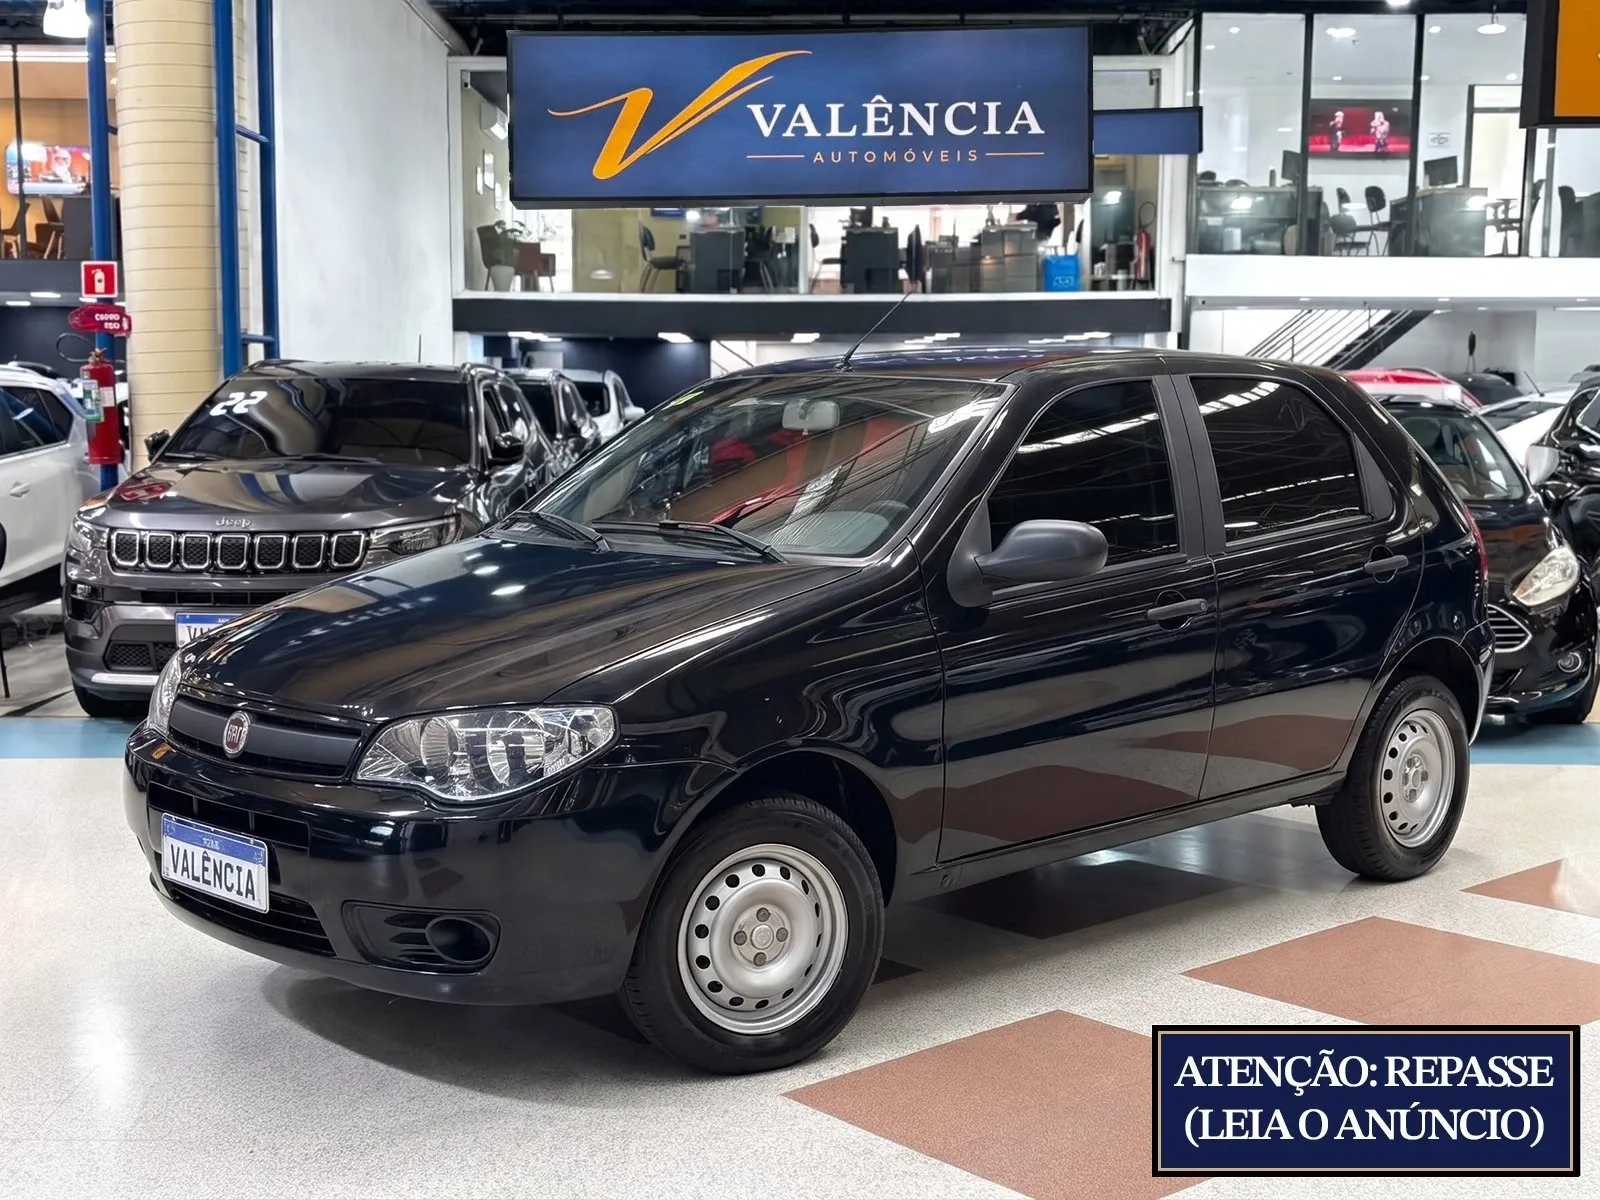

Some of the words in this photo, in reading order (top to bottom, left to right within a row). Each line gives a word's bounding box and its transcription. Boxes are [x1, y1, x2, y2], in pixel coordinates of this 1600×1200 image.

[746, 94, 1045, 138] VALÊNCIA
[812, 147, 979, 164] AUTOMÓVEIS
[215, 516, 252, 528] Jeep
[170, 843, 256, 901] VALÊNCIA
